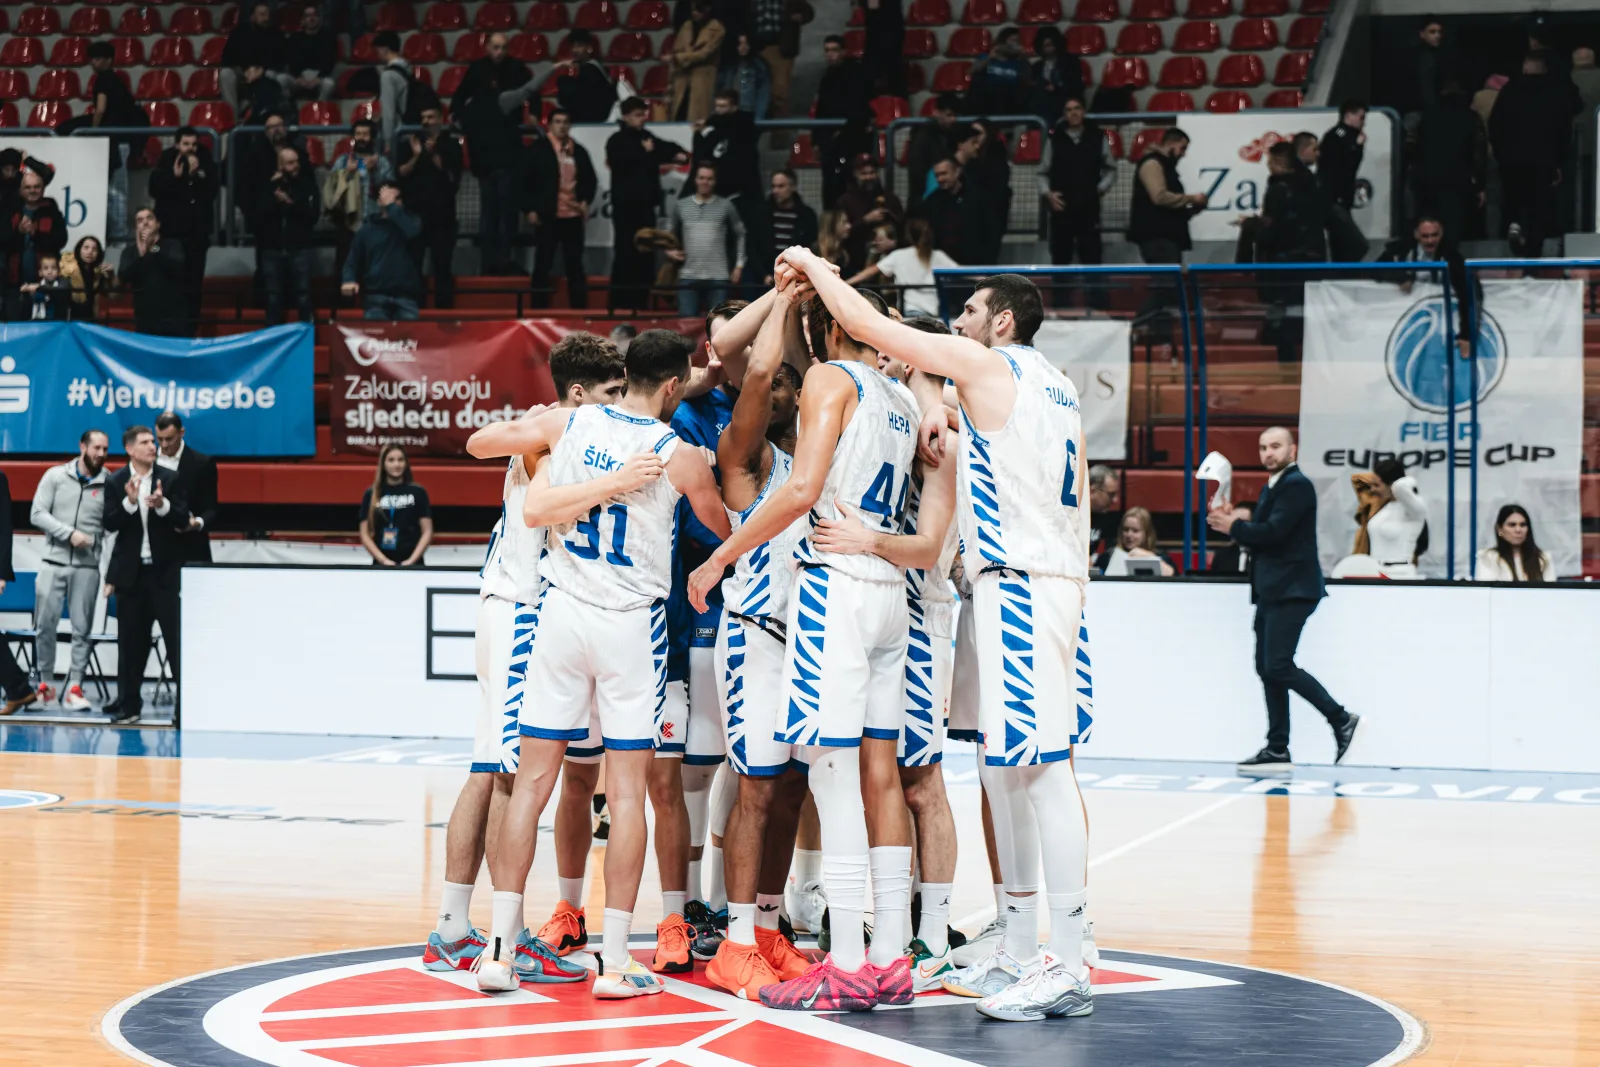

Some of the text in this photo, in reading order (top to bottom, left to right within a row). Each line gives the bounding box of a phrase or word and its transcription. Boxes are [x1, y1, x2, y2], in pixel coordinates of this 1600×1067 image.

[67, 378, 276, 415] #vjerujusebe
[344, 374, 491, 404] Zakucaj svoju
[344, 402, 450, 433] sljedeću
[887, 410, 911, 438] HEPA
[1399, 421, 1482, 443] FIBA
[1323, 443, 1556, 470] EUROPE CUP
[564, 503, 634, 567] 31
